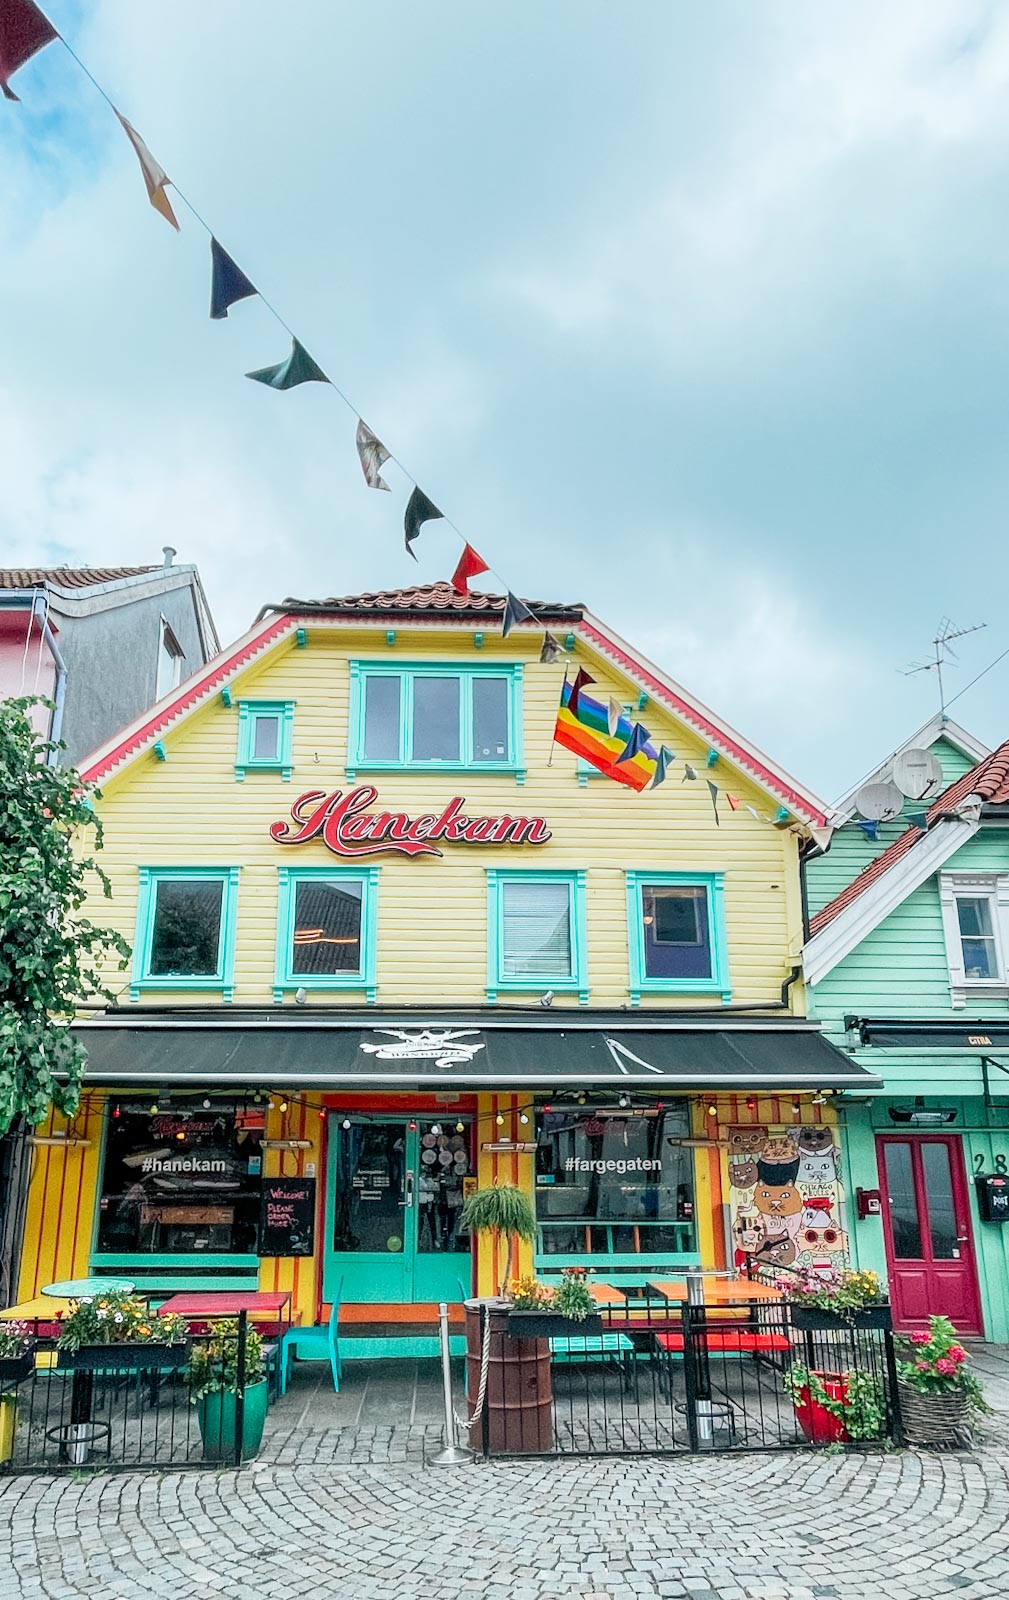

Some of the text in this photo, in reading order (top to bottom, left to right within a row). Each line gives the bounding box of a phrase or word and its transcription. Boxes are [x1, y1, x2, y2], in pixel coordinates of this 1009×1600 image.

[269, 784, 553, 858] Hanekam
[141, 1157, 226, 1172] #hanekam
[565, 1157, 662, 1174] #fargegaten
